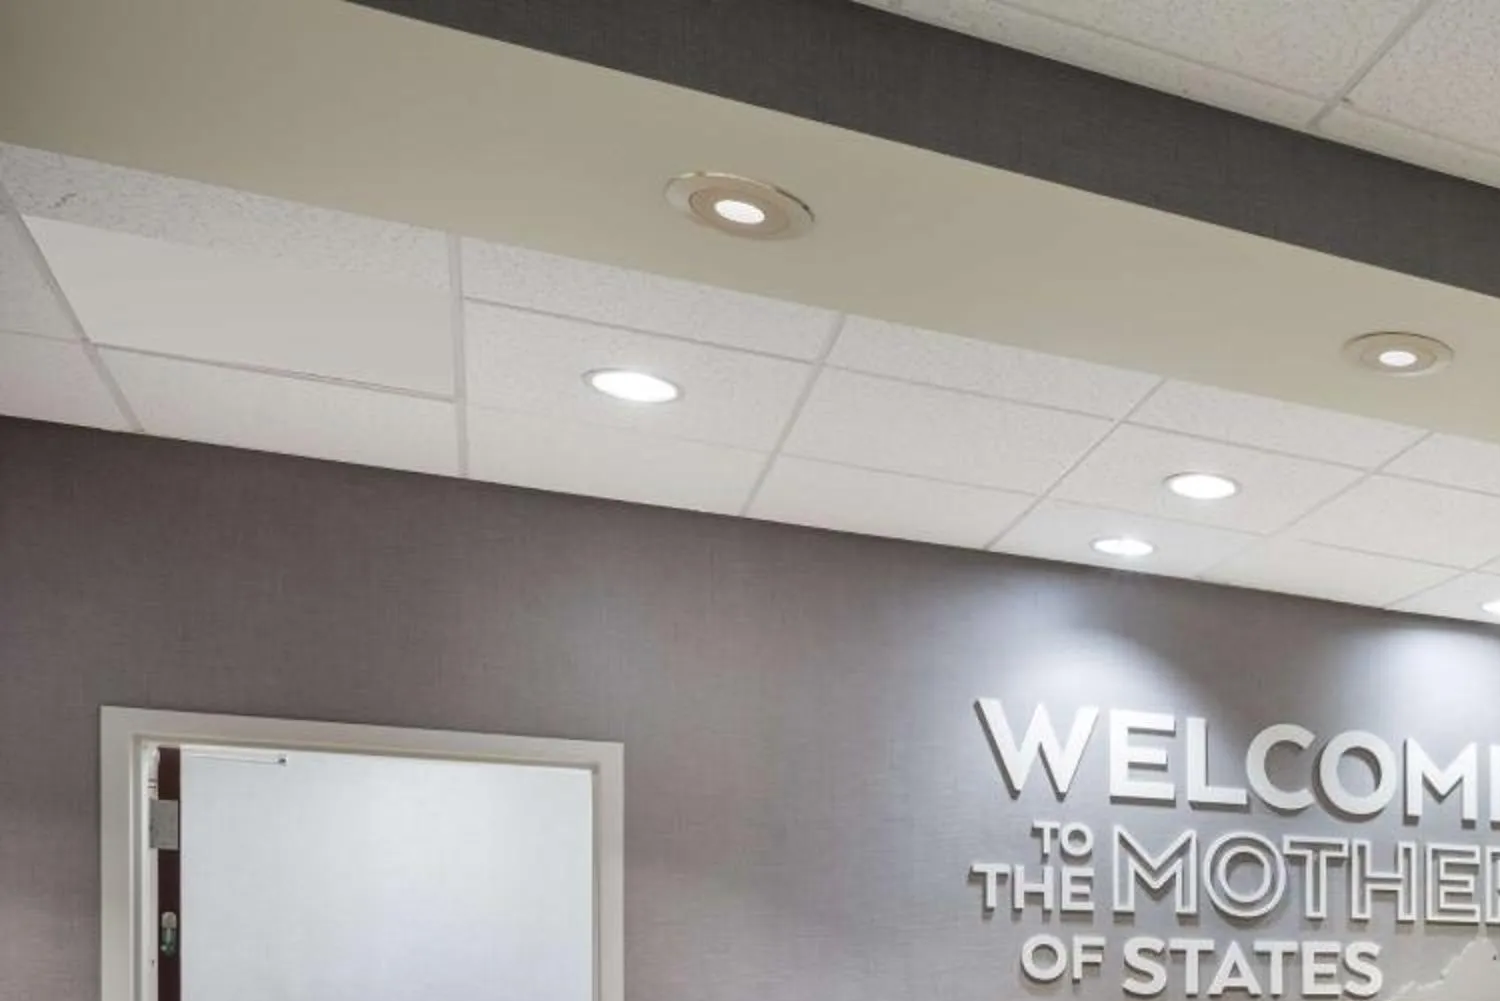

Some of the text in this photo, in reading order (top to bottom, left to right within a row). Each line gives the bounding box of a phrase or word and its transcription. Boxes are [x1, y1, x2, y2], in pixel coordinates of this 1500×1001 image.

[1032, 818, 1094, 857] TO
[969, 863, 1095, 912] THE
[1020, 934, 1384, 997] OF STATES
